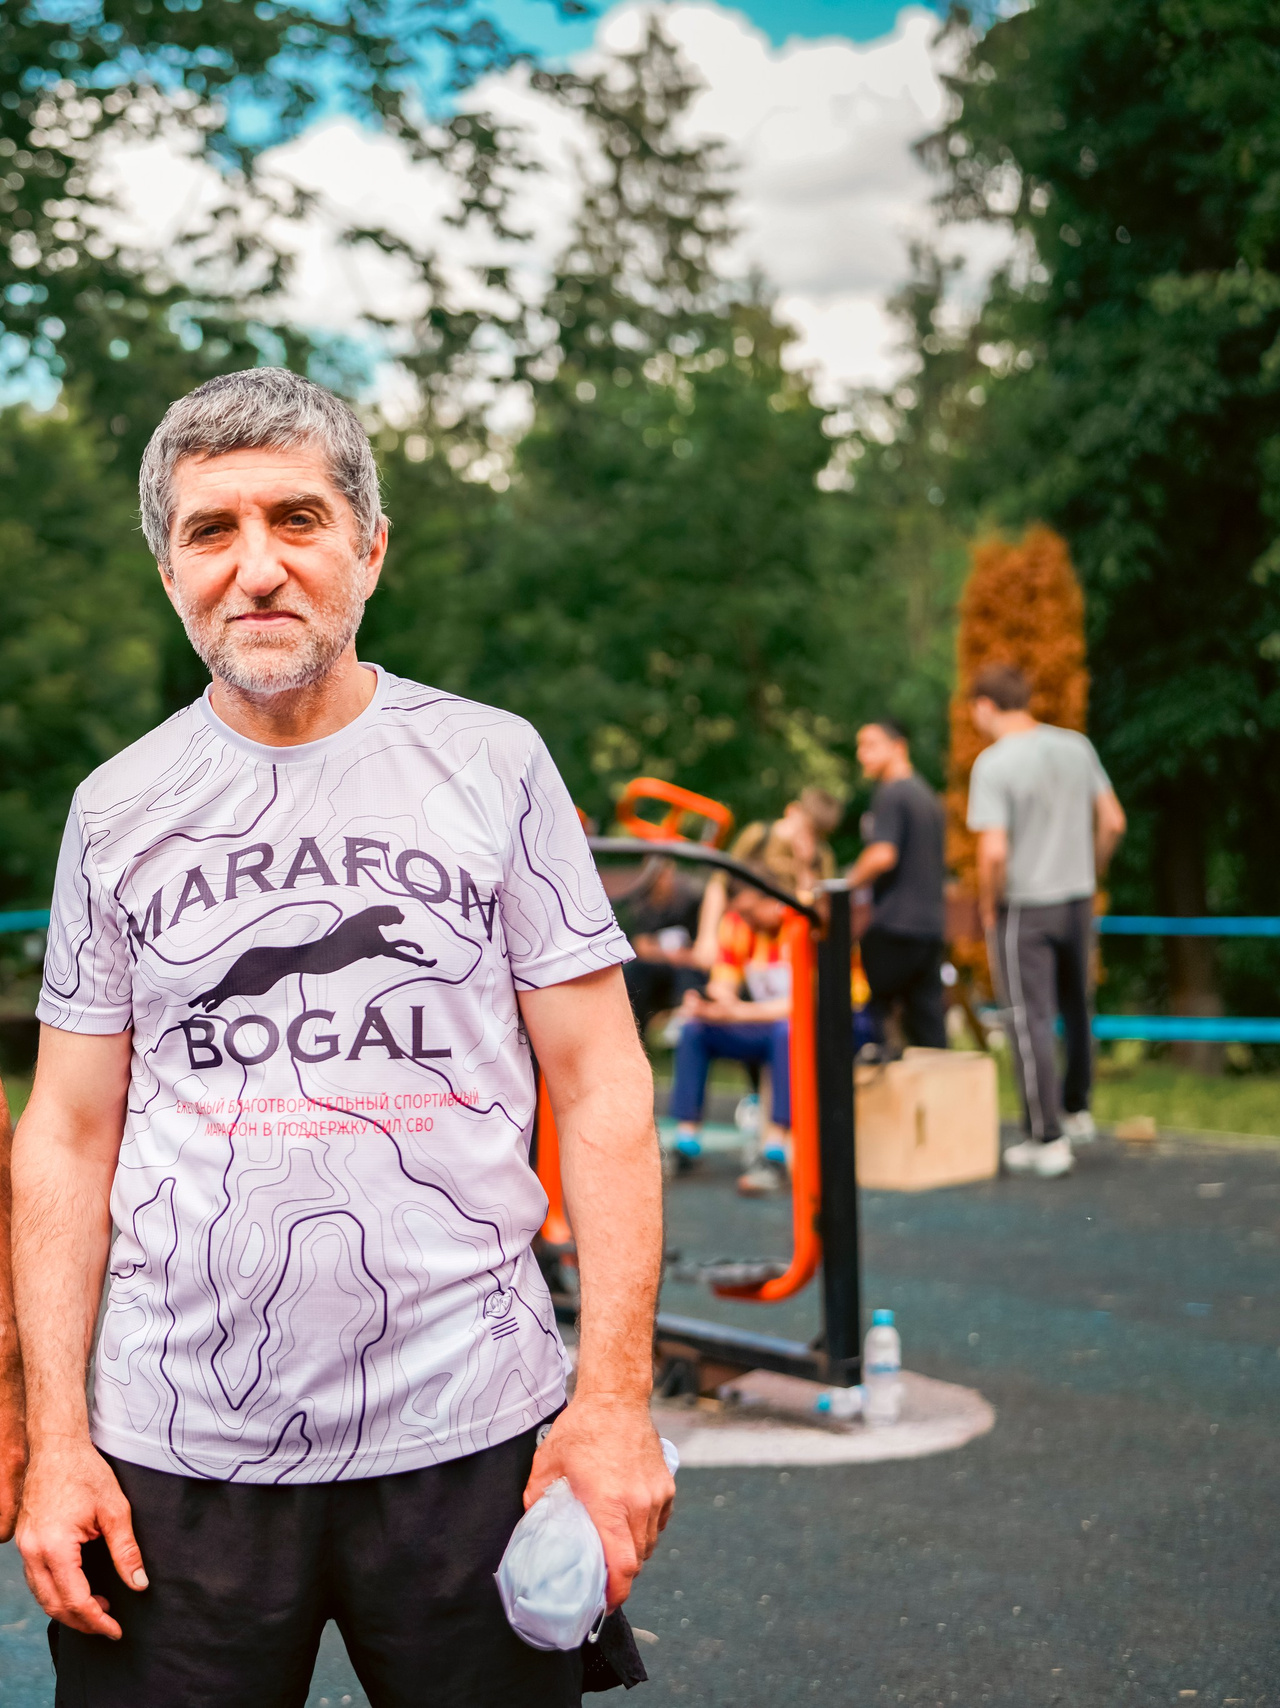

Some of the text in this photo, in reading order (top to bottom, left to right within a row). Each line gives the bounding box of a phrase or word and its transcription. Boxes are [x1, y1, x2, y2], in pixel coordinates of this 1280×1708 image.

[125, 836, 499, 951] MARAFON
[179, 1005, 453, 1070] BOGAL
[228, 1093, 389, 1114] БЛАГОТВОРИТЕЛЬНЫЙ
[394, 1087, 480, 1109] СПОРТИВНЫЙ
[204, 1116, 434, 1138] МАРАФОН В ПОДДЕРЖКУ СИЛ СВО
